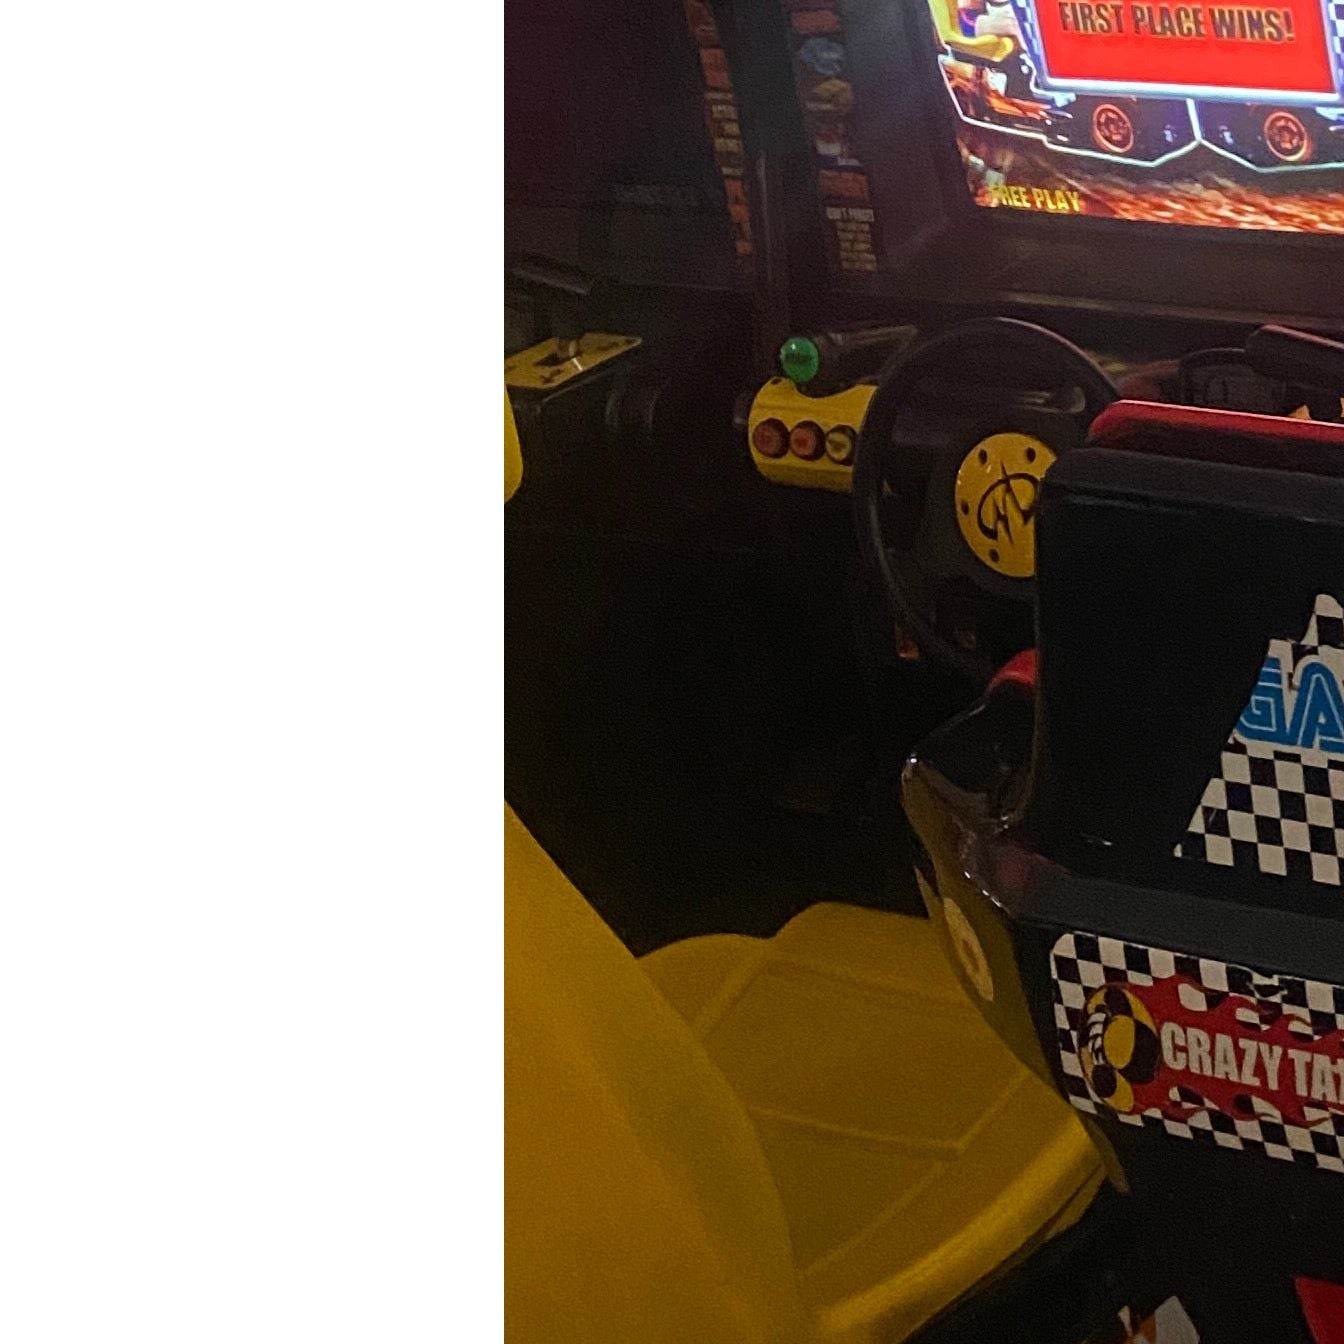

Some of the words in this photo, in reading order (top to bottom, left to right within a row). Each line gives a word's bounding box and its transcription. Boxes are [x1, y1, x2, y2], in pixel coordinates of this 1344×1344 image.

[1058, 1, 1123, 34] FIRST
[1131, 4, 1206, 37] PLACE
[1209, 7, 1295, 41] WINS!
[989, 185, 1031, 208] FREE
[1031, 187, 1081, 212] PLAY
[1160, 1020, 1282, 1092] CRAZY
